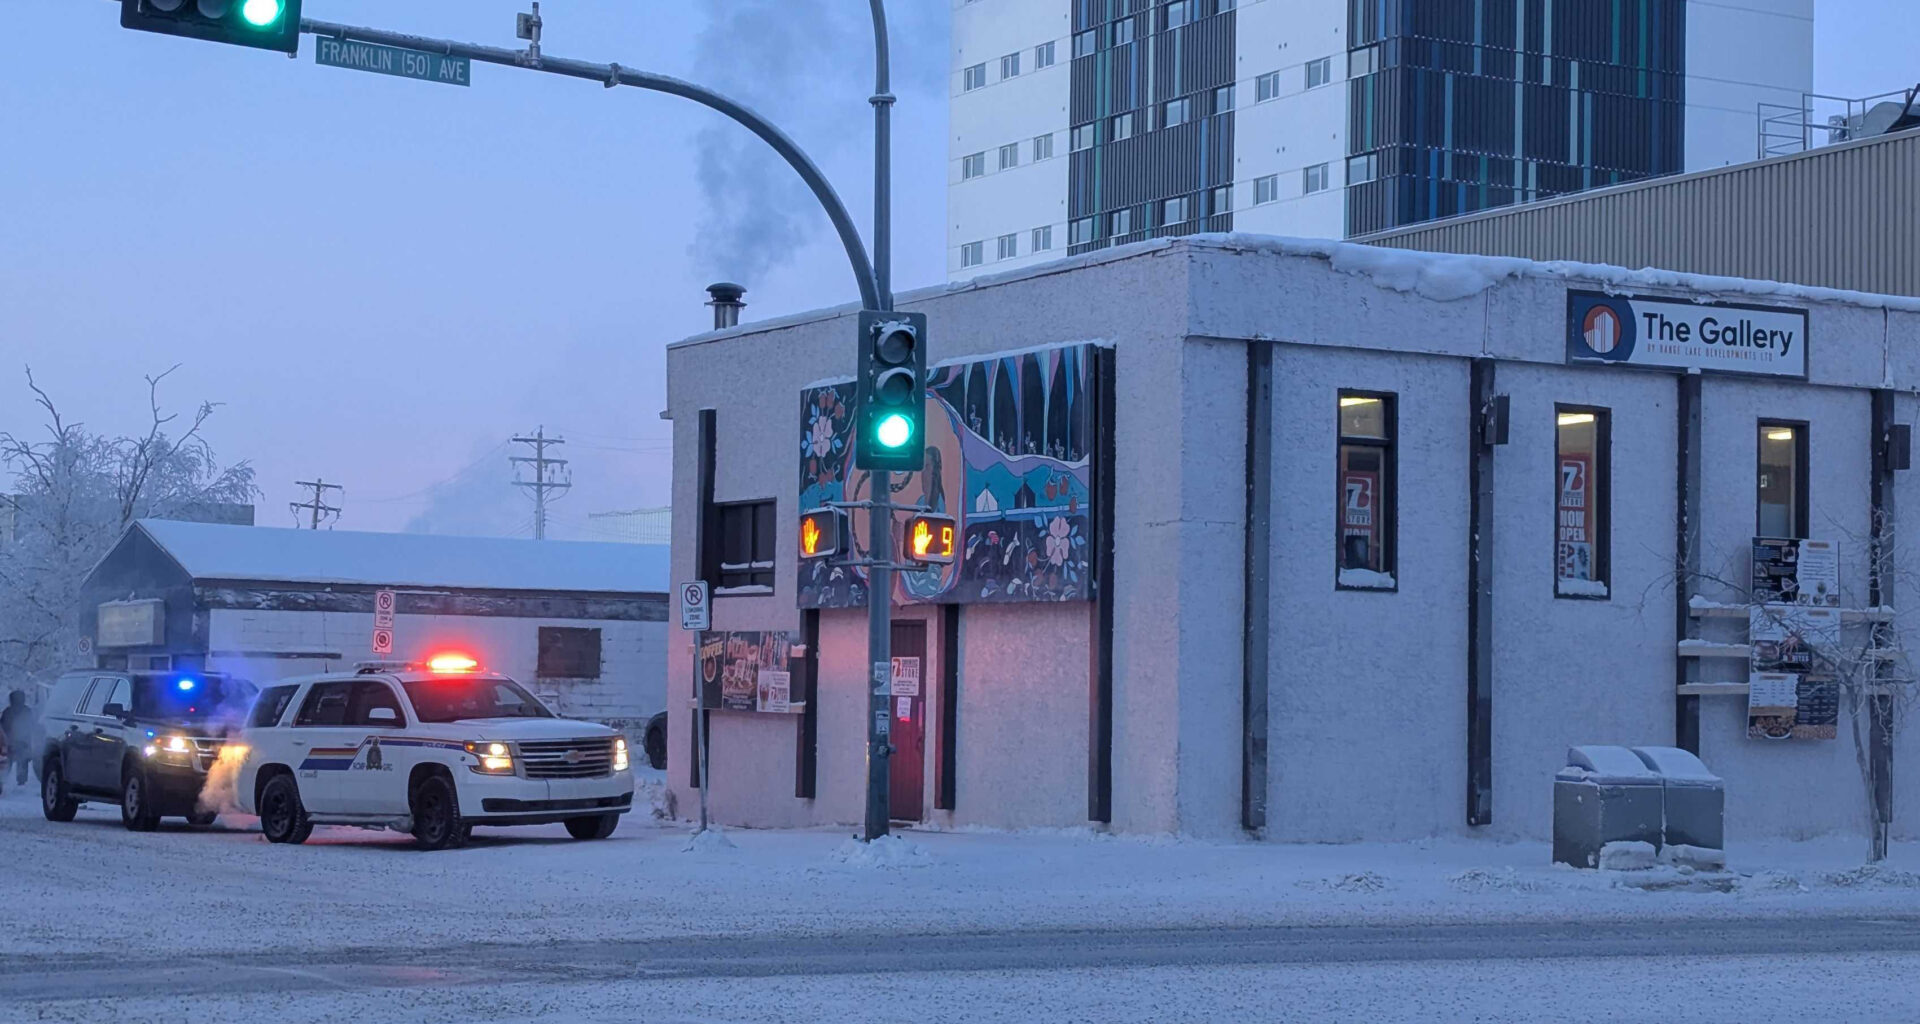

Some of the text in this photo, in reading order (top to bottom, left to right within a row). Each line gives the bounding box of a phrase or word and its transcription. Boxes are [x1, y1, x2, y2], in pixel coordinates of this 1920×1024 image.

[321, 41, 465, 82] FRANKLIN (50) AVE
[1642, 312, 1793, 357] The Gallery
[1560, 510, 1585, 527] NOW
[942, 526, 953, 556] 9
[1560, 527, 1585, 541] OPEN
